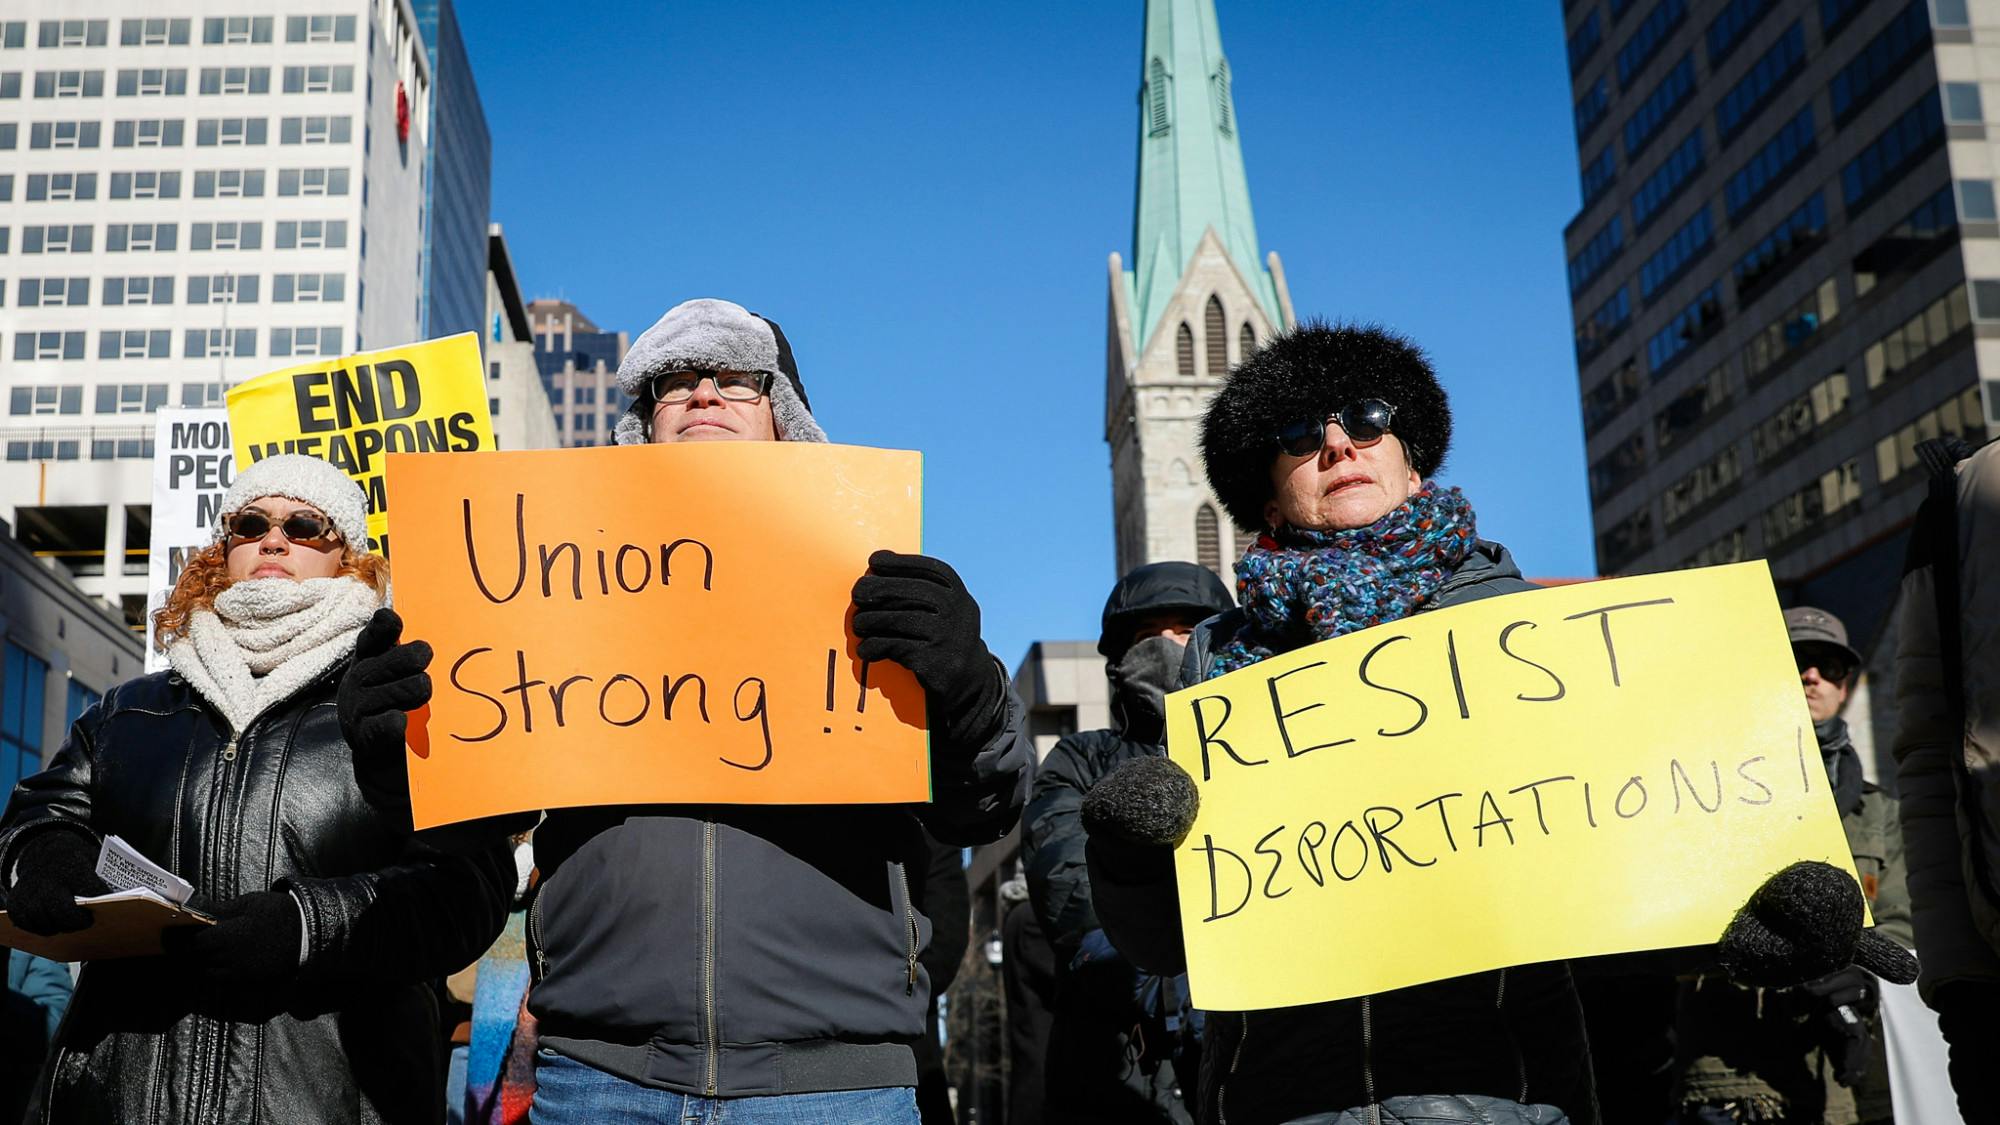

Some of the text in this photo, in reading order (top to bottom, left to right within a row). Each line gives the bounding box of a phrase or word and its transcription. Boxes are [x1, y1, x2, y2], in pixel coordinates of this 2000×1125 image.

[293, 359, 421, 434] END
[171, 422, 230, 449] MO
[463, 493, 713, 603] Union
[449, 647, 773, 771] Strong
[1191, 598, 1675, 781] RESIST
[1191, 725, 1811, 923] DEPORTATIONS!
[104, 863, 116, 874] AND
[105, 856, 156, 888] DEPORTATIONS
[108, 847, 165, 884] WHY WE SHOULD
[120, 861, 145, 878] REJECT
[146, 875, 168, 889] MASS
